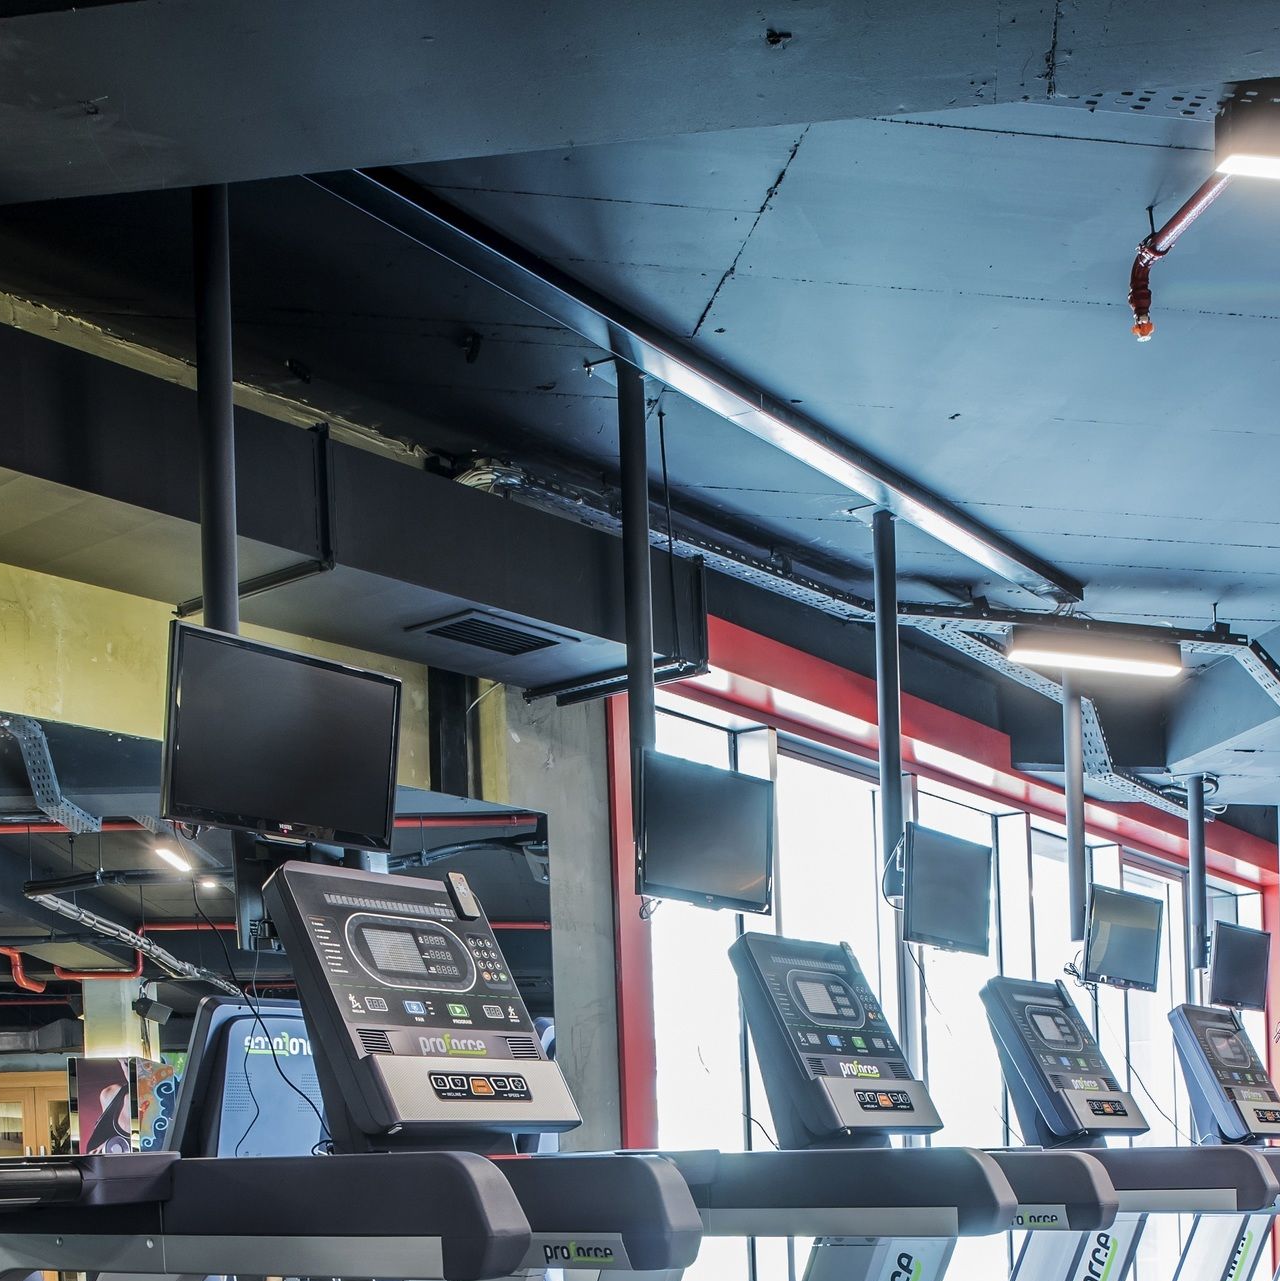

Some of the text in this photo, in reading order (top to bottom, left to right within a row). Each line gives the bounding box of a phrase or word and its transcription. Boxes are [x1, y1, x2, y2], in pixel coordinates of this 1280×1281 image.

[418, 1033, 487, 1056] proforce
[840, 1060, 880, 1078] proforce
[544, 1241, 614, 1264] proforce
